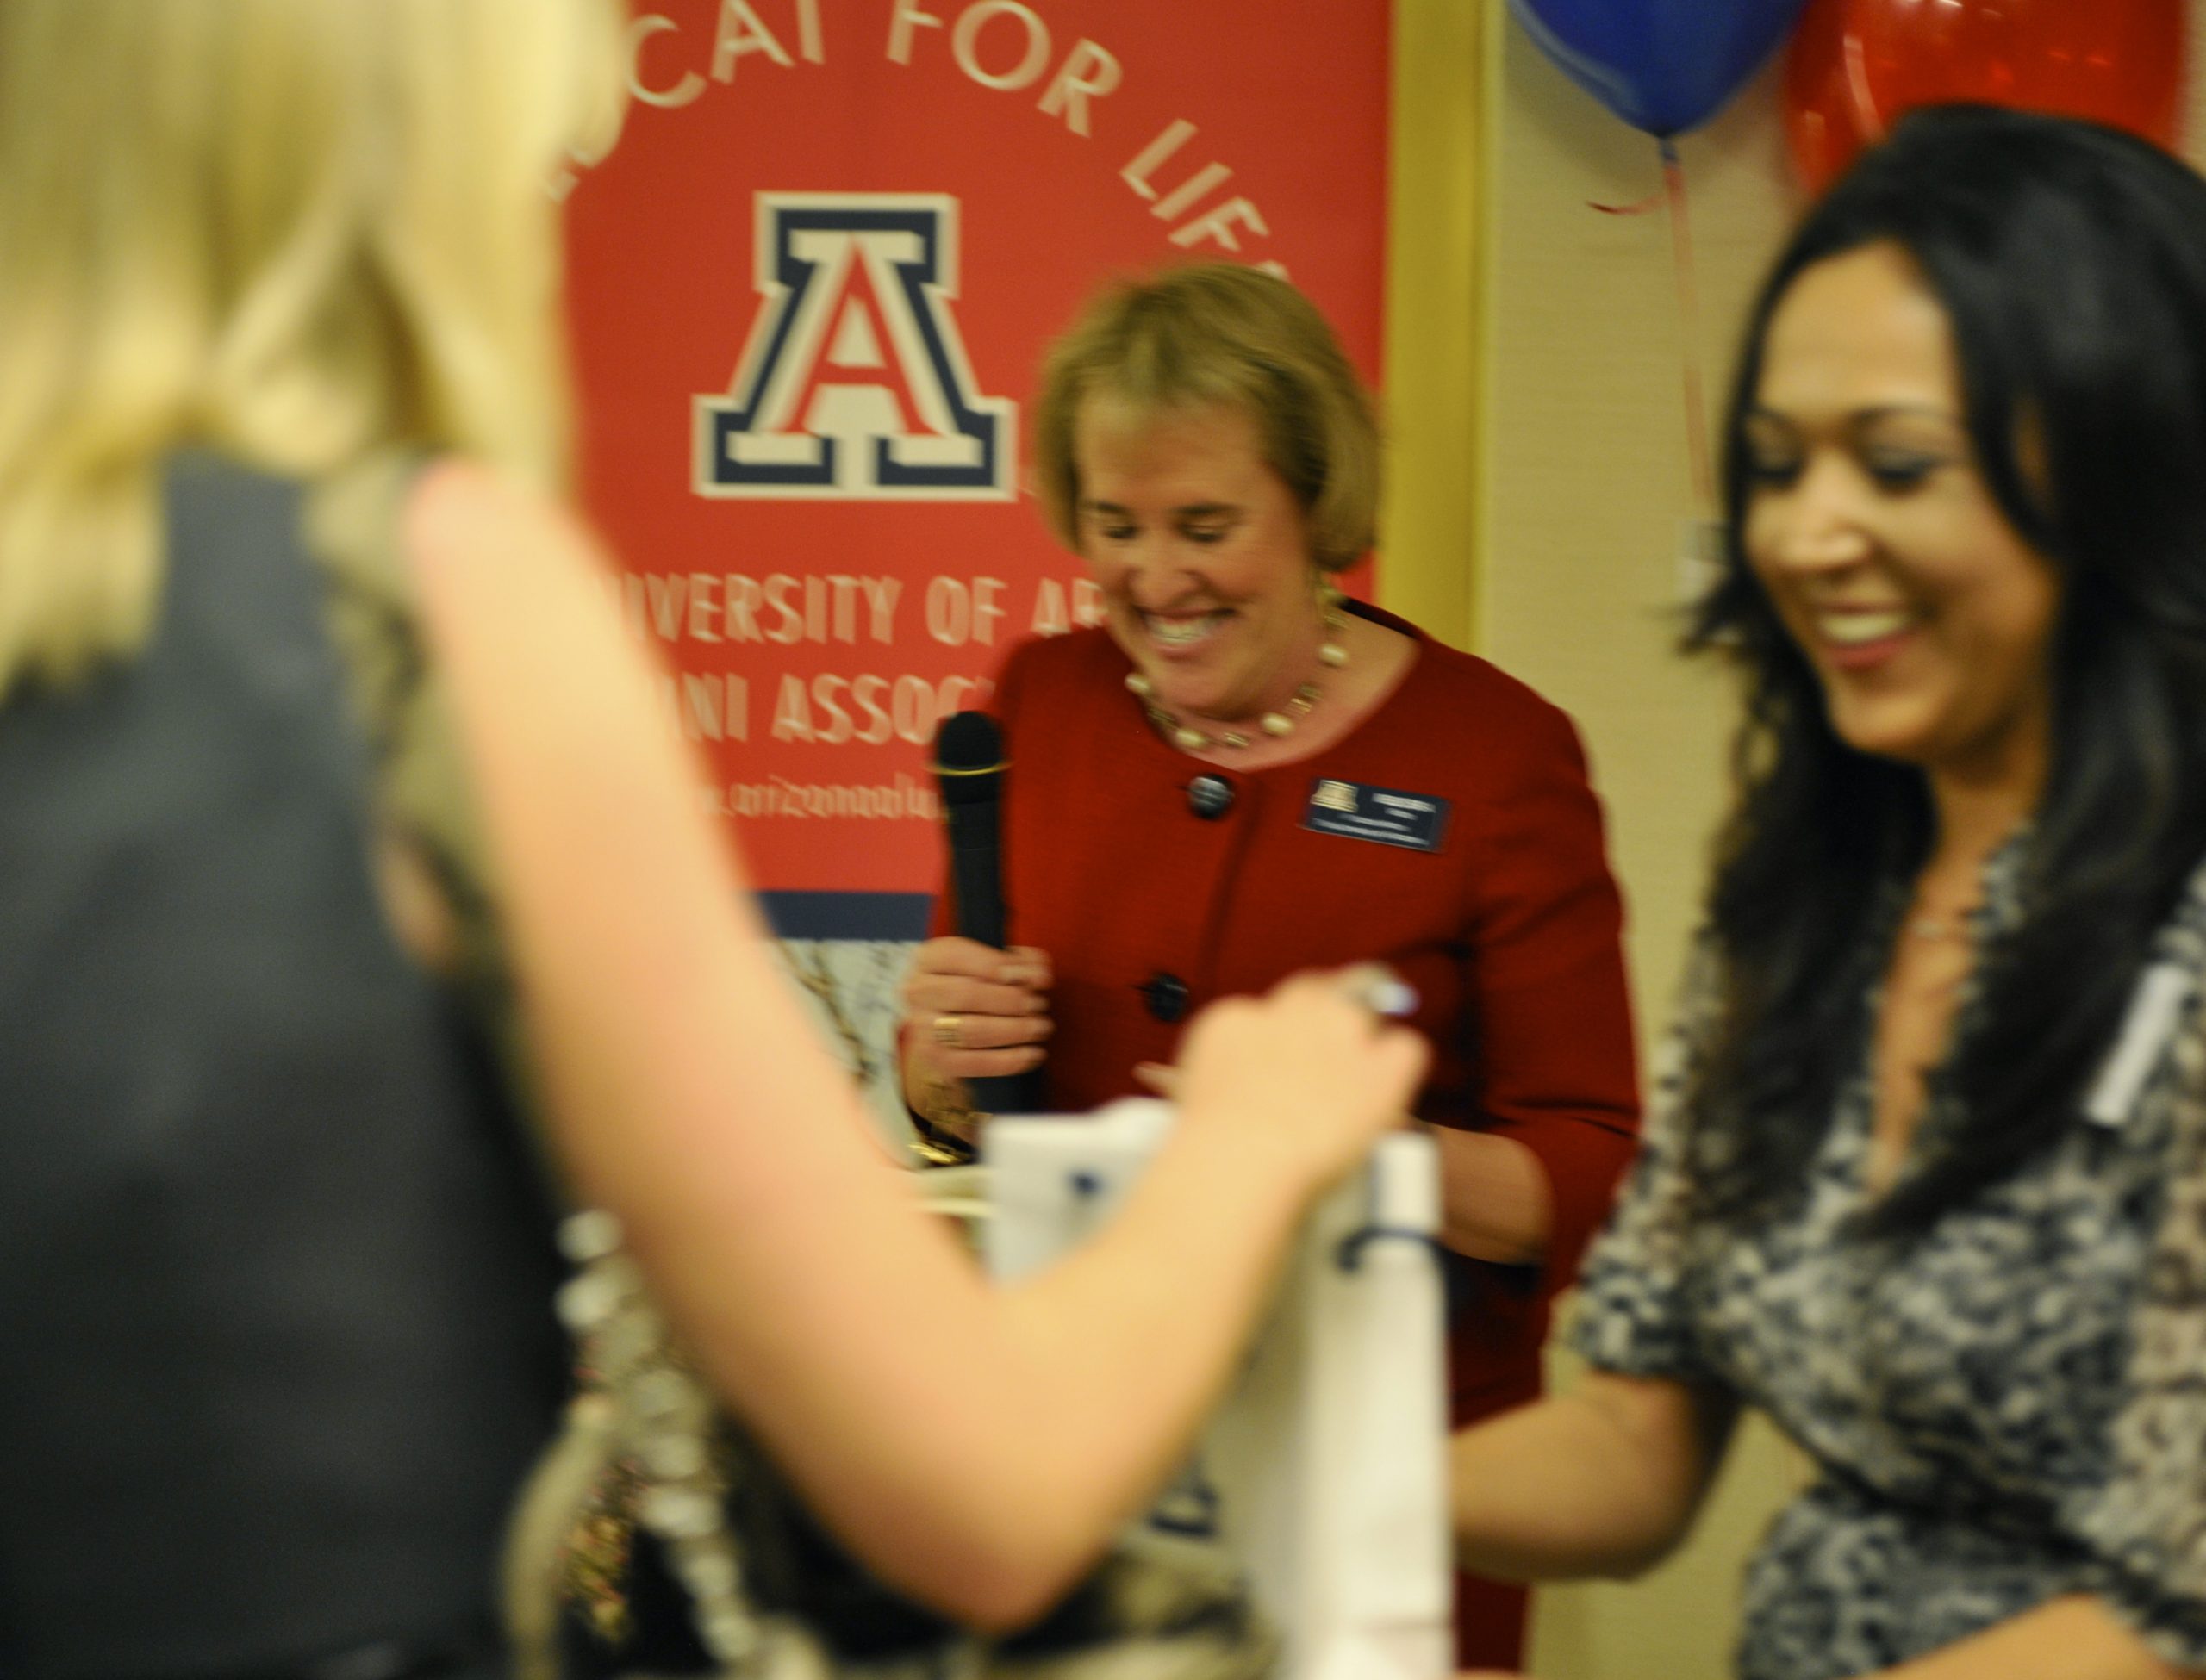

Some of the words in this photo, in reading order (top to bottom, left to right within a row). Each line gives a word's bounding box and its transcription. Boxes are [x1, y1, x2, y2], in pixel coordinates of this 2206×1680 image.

[886, 0, 1123, 139] FOR
[1120, 118, 1289, 283] LIF
[692, 191, 1019, 503] A
[924, 574, 1008, 646] OF
[1030, 576, 1112, 639] AR
[665, 670, 749, 744] NI
[771, 672, 998, 747] ASSOC
